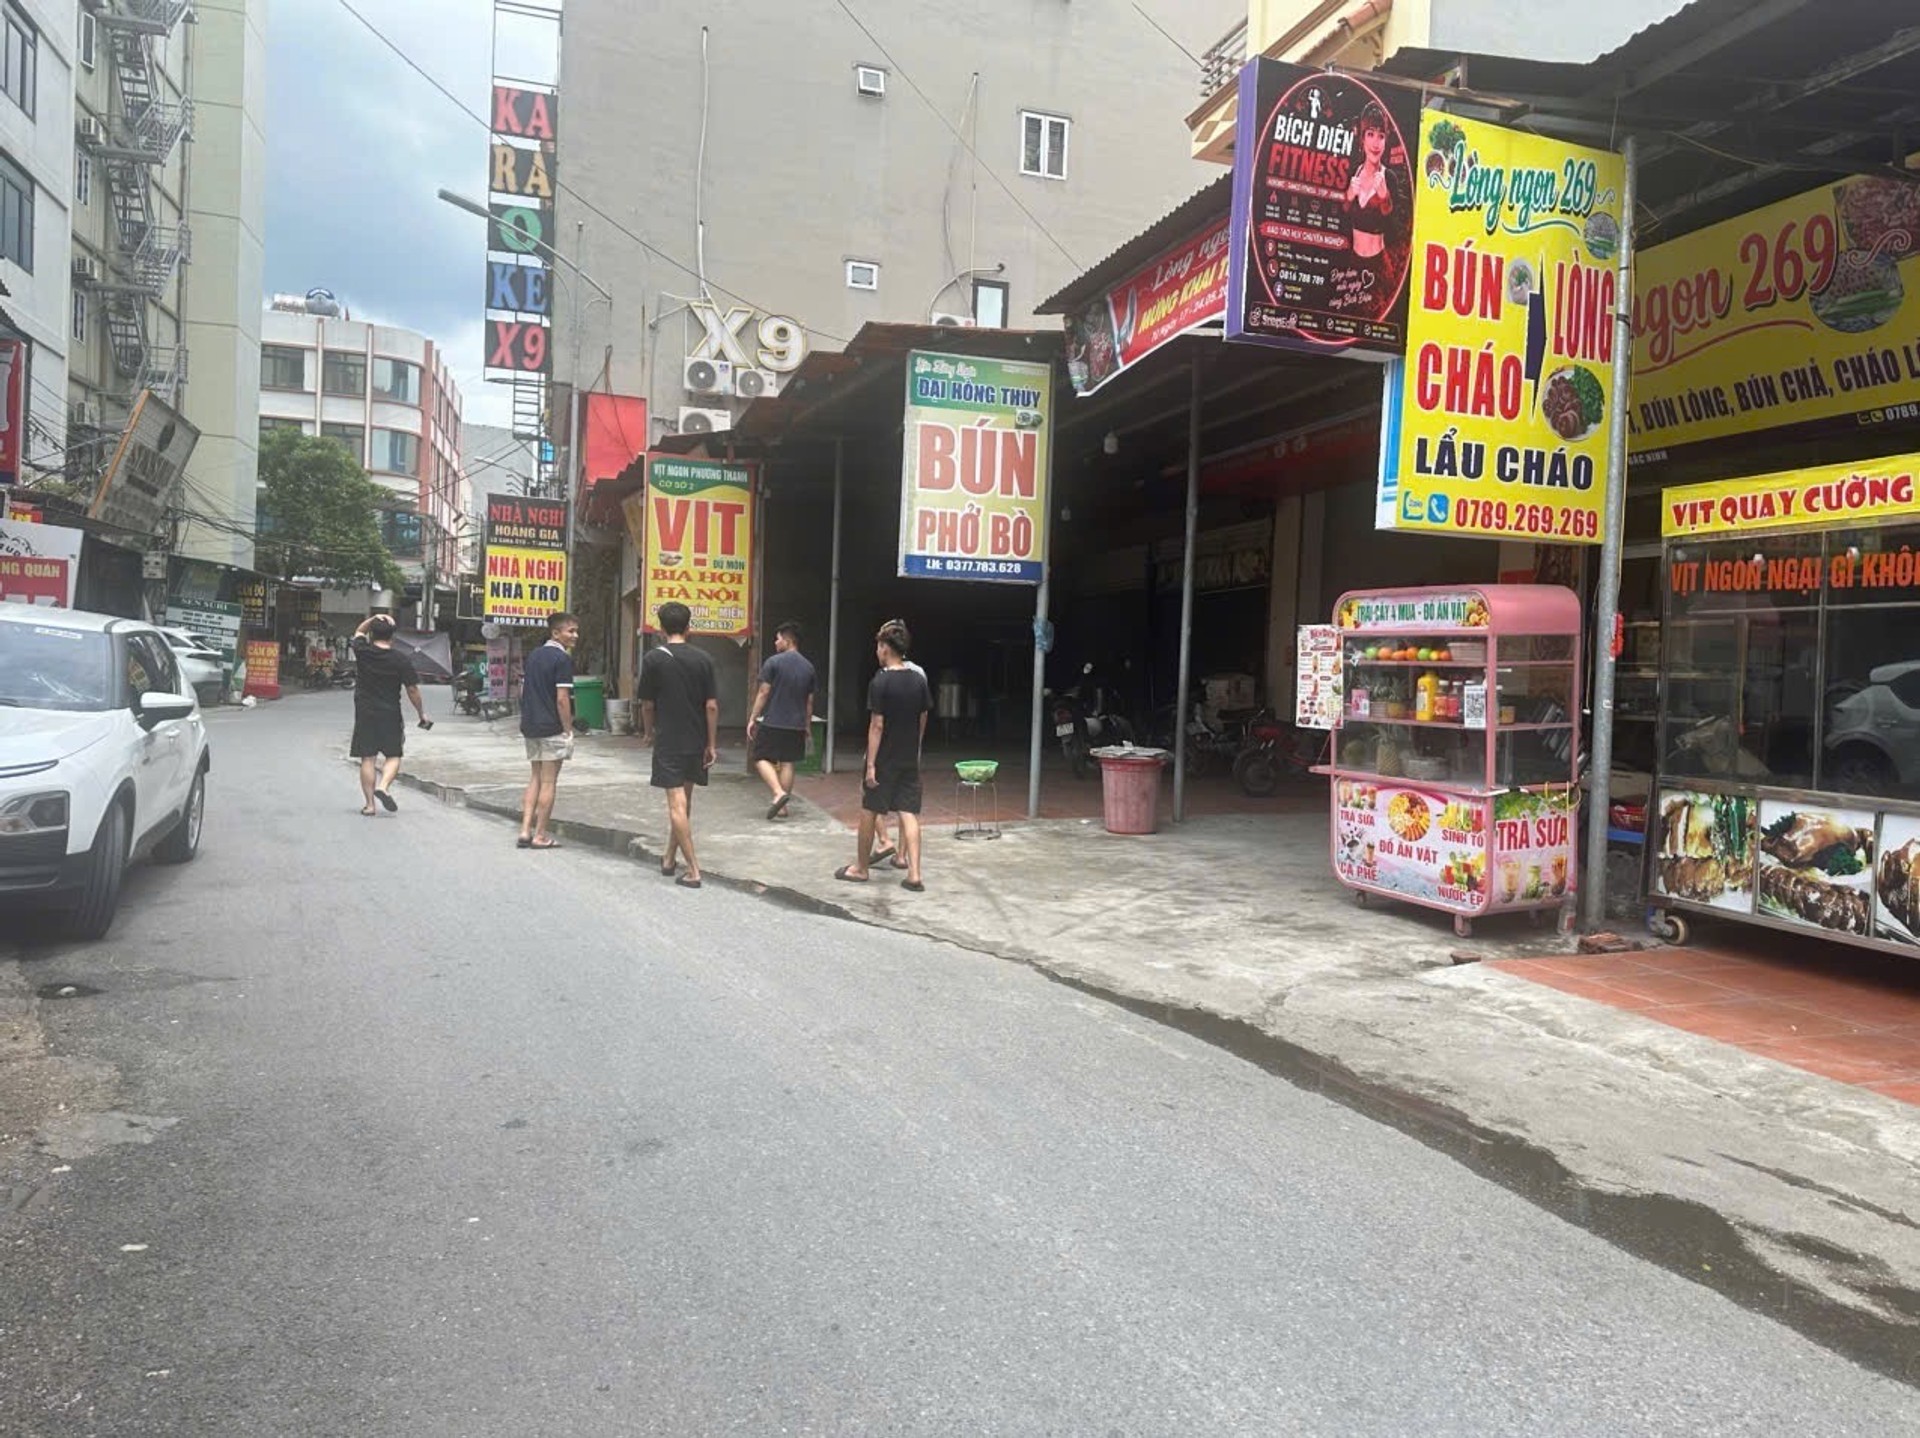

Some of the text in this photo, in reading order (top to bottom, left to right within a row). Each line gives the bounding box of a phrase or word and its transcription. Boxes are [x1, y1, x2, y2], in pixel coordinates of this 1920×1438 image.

[493, 86, 553, 139] KA
[1274, 112, 1315, 147] BÍCH
[491, 144, 551, 197] RA
[1267, 142, 1350, 189] FITNESS
[1449, 141, 1597, 235] Lòng ngon 269
[500, 205, 542, 251] O
[1198, 228, 1230, 260] ngo
[1423, 238, 1504, 321] BÚN
[1738, 211, 1841, 311] 269
[490, 262, 547, 313] KE
[1552, 249, 1616, 365] LÒNG
[490, 321, 546, 371] X9
[688, 301, 806, 373] X9
[917, 377, 947, 403] ĐẠI
[1416, 341, 1523, 421] CHÁO
[1639, 395, 1680, 432] BÚN
[1733, 373, 1780, 412] BÚN
[1833, 346, 1902, 392] CHÁO
[918, 417, 1038, 500] BÚN
[1415, 428, 1594, 492] LẨU CHÁO
[489, 501, 566, 528] NHÀ NGHỈ
[1454, 499, 1599, 539] 0789.269.269
[1671, 474, 1914, 531] VỊT QUAY CƯỜNG
[494, 523, 559, 541] HOÀNG GIA
[652, 496, 746, 568] VỊT
[917, 501, 1033, 558] PHỞ BÒ
[488, 554, 564, 582] NHÀ NGHỈ
[490, 581, 523, 600] NHÀ
[651, 568, 744, 585] BIA HƠI
[1671, 562, 1700, 597] VỊT
[1704, 560, 1762, 592] NGON
[1766, 557, 1822, 595] NGẠI
[655, 584, 740, 604] HÀ NỘI
[1379, 838, 1393, 854] ĐỒ
[1441, 829, 1468, 845] SINH
[1496, 808, 1570, 852] TRÀ SỮA
